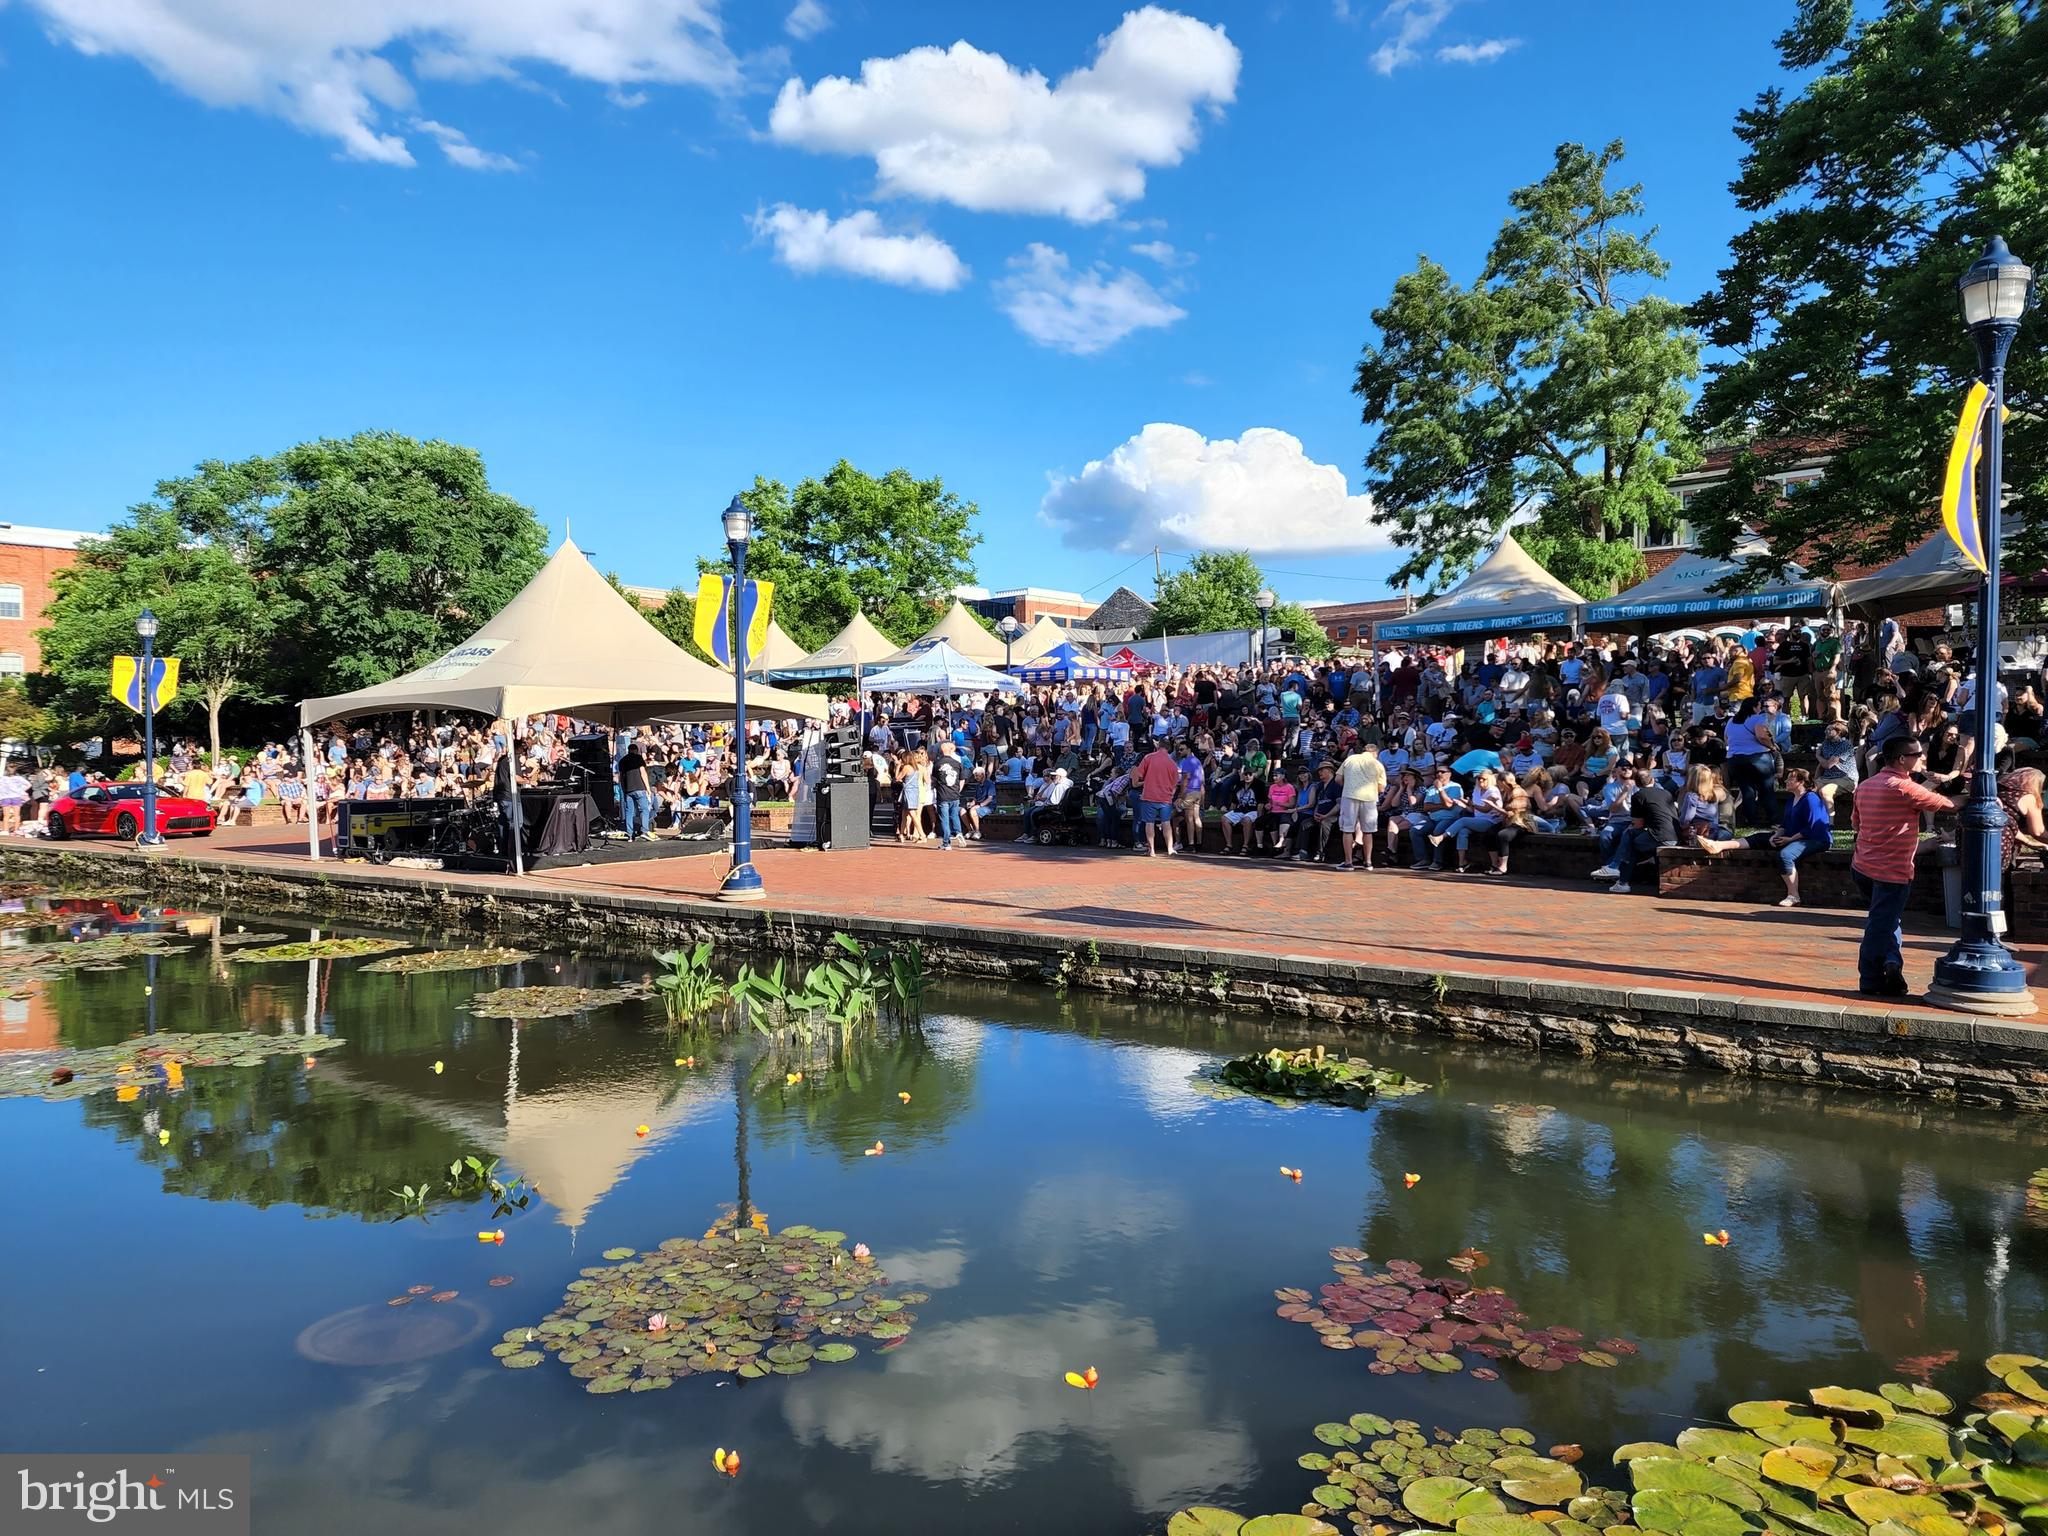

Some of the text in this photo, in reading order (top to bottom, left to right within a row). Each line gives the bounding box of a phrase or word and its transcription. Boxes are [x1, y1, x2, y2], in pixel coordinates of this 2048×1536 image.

[1592, 592, 1815, 620] FOOD FOOD FOOD FOOD FOOD FOOD FOOD
[1381, 612, 1564, 638] TOKENS TOKENS TOKENS TOKENS TOKENS
